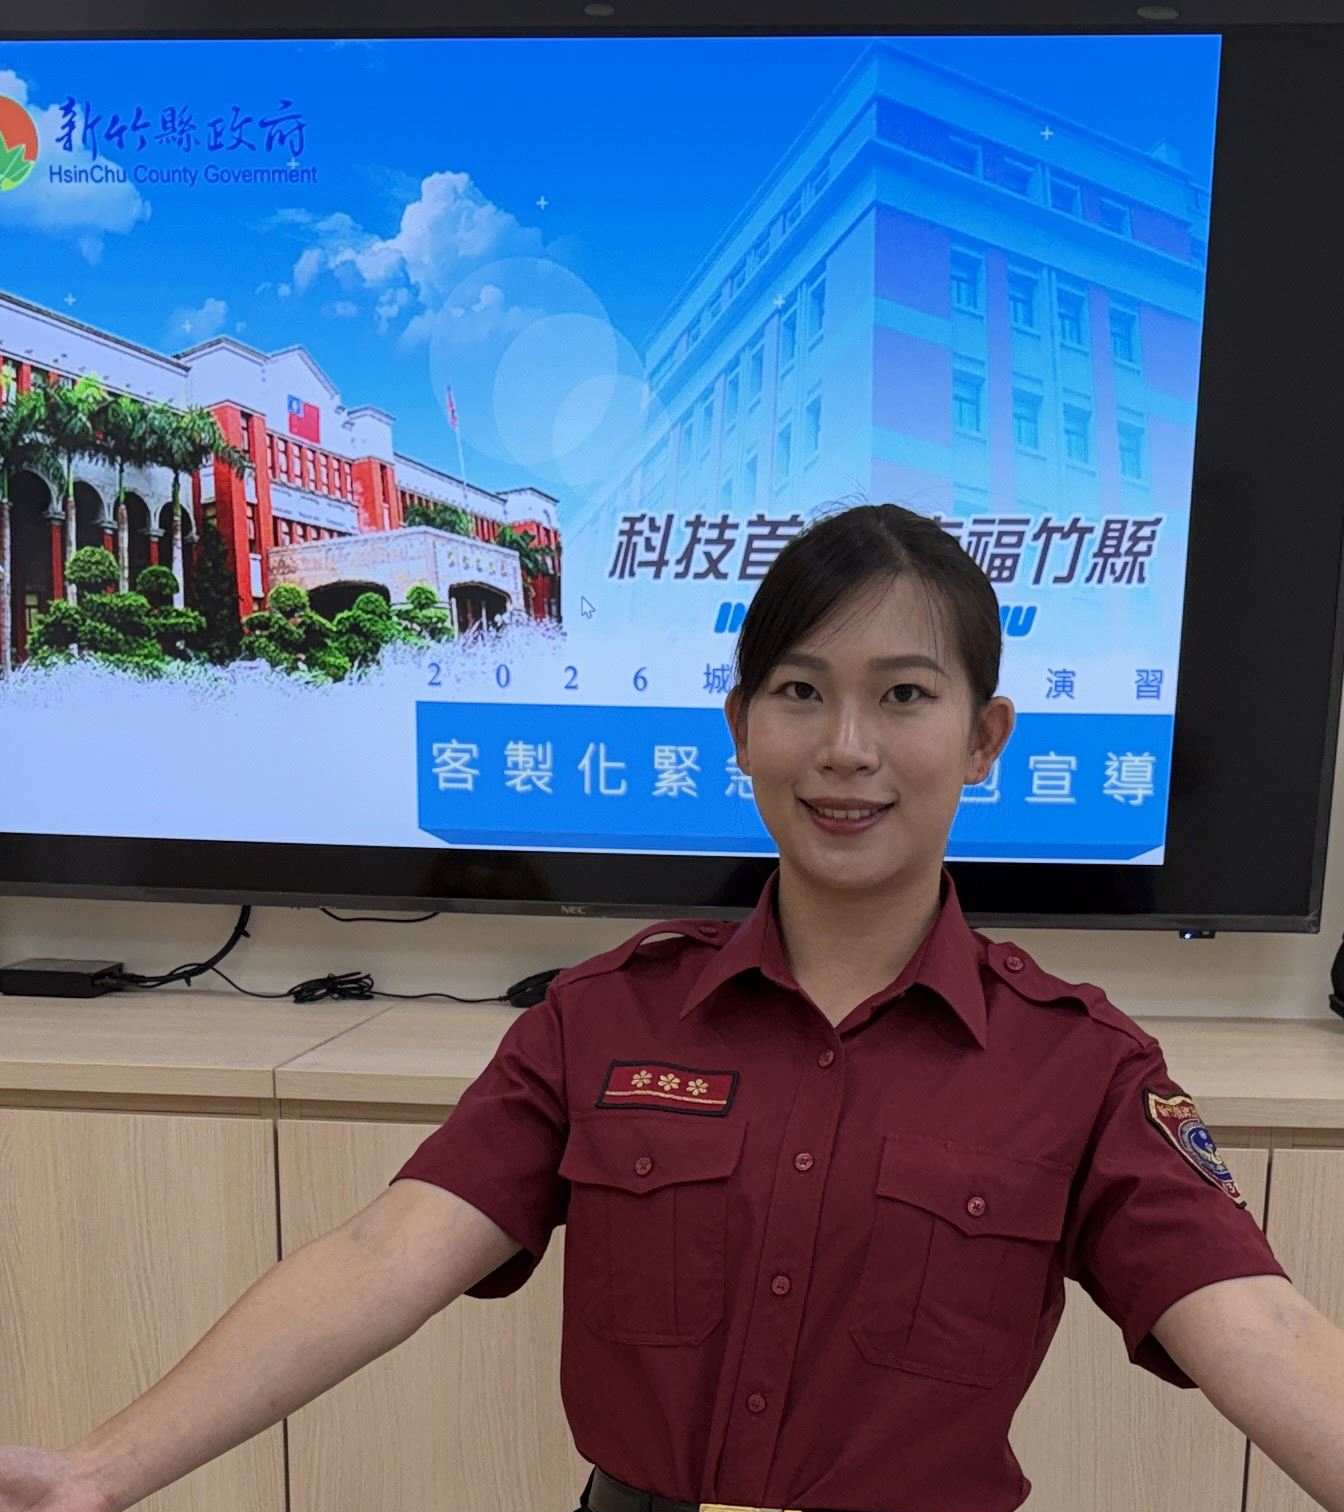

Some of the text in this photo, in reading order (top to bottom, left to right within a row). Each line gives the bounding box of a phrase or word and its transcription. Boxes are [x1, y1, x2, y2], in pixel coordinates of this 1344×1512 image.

[56, 97, 307, 160] 新竹縣政府
[49, 164, 318, 187] HsinChu County Government
